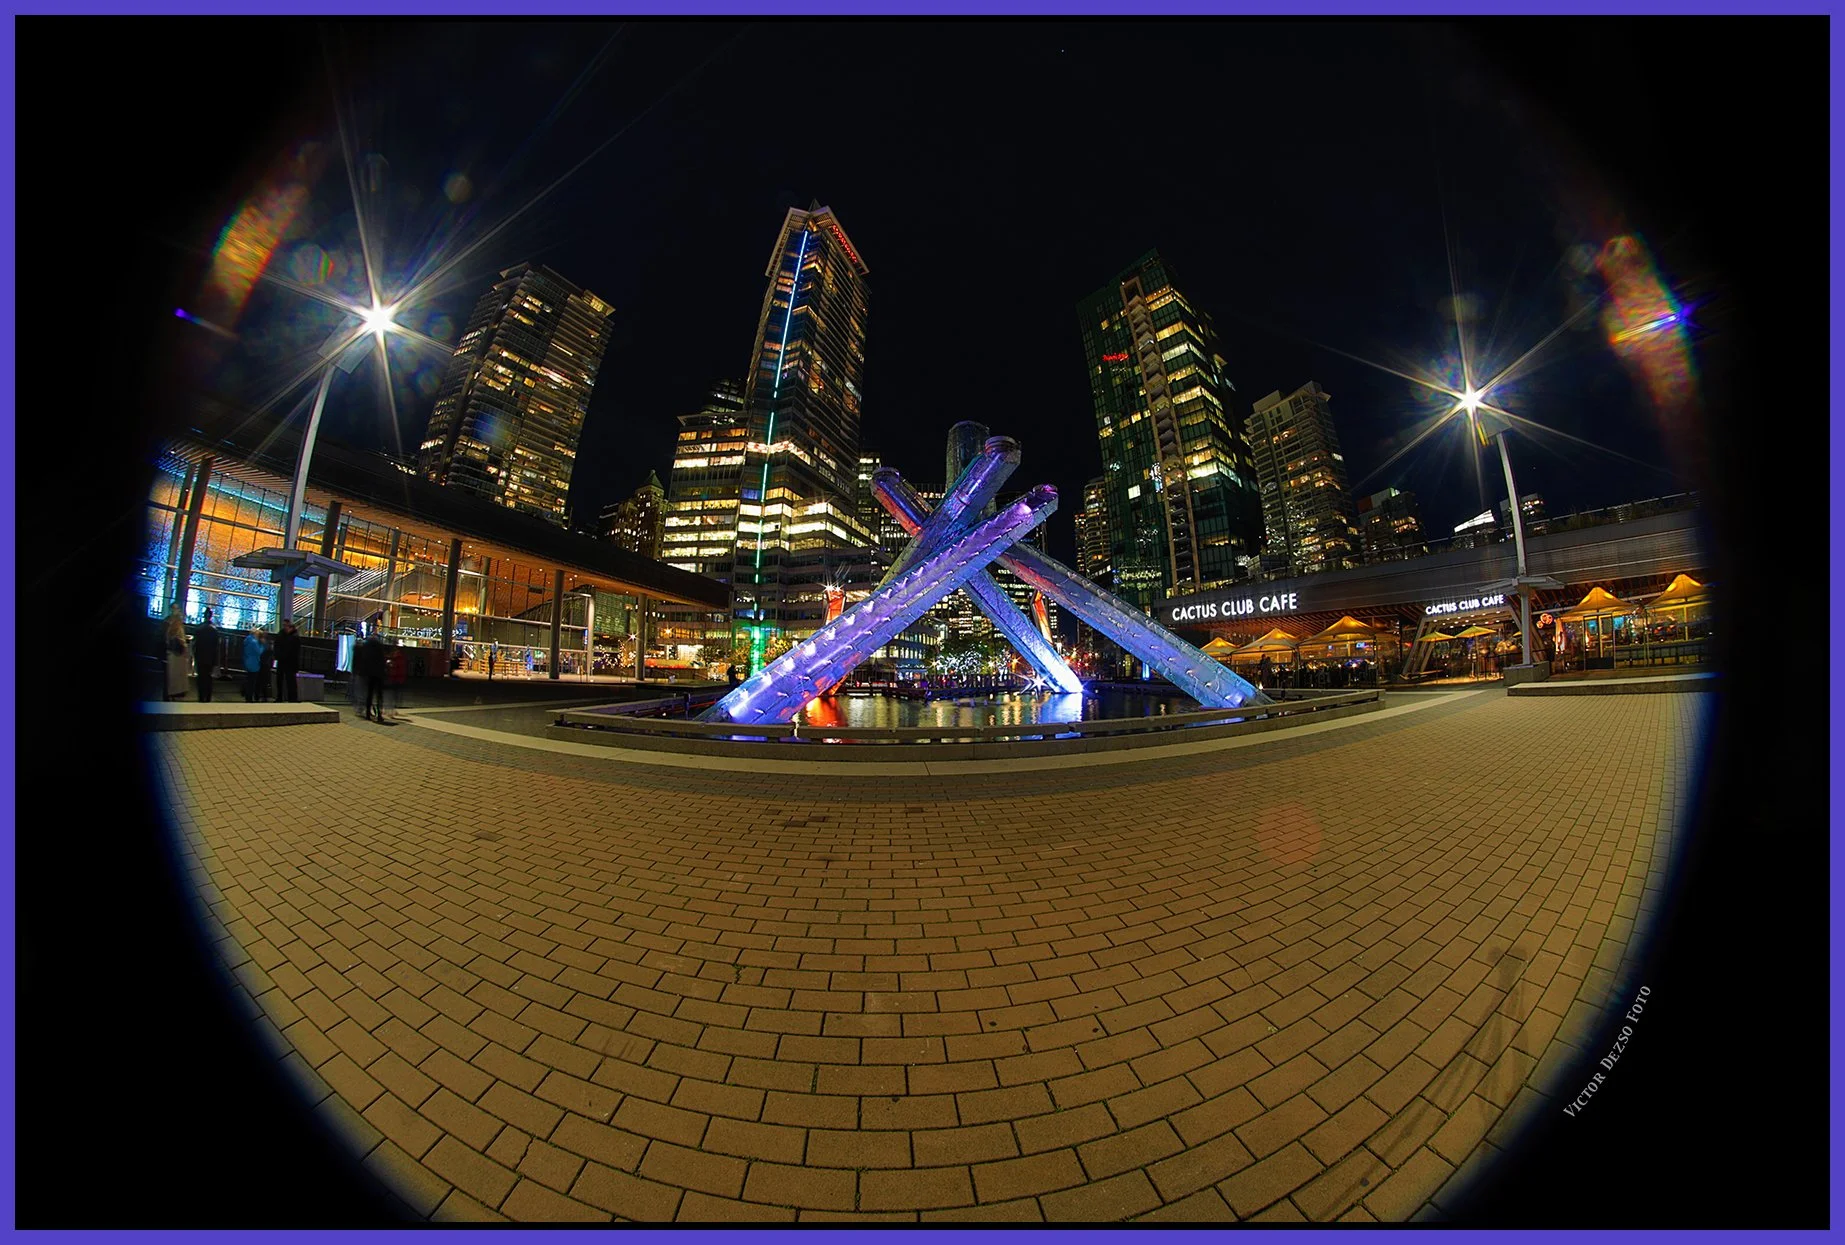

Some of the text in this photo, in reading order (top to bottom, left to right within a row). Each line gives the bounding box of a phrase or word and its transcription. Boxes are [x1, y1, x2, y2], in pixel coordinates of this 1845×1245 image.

[1171, 593, 1298, 621] CACTUS CLUB CAFE
[1425, 594, 1504, 615] CACTUS CLUB CAFE
